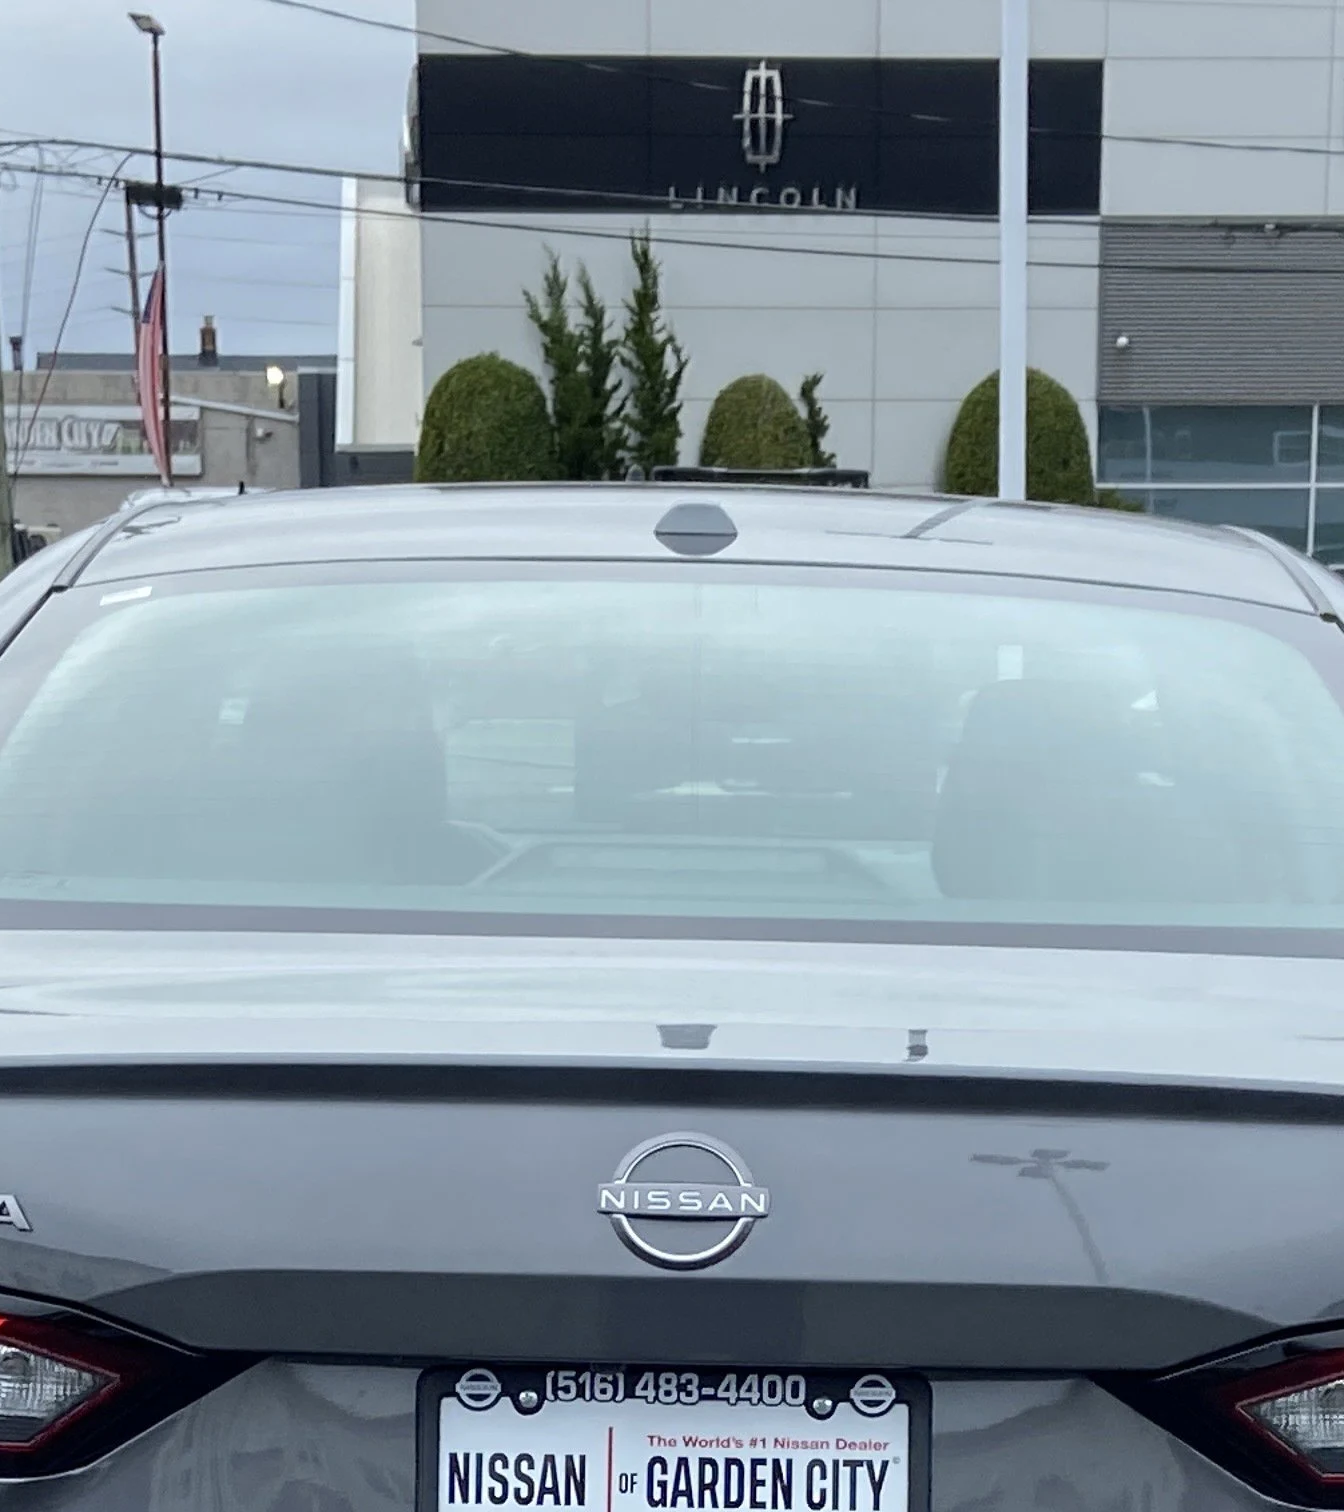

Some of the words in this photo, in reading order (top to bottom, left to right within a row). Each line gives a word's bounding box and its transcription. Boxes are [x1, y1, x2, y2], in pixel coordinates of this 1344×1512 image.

[668, 186, 856, 210] LINCOLN
[600, 1189, 765, 1212] NISSAN
[545, 1370, 625, 1402] (516)
[635, 1372, 806, 1406] 483-4400
[647, 1435, 677, 1448] The
[682, 1435, 744, 1449] World's
[749, 1437, 767, 1449] #1
[773, 1437, 830, 1450] Nissan
[835, 1438, 890, 1451] Dealer
[448, 1452, 586, 1506] NISSAN
[619, 1472, 638, 1494] OF
[647, 1456, 793, 1510] GARDEN
[806, 1458, 890, 1511] CITY
